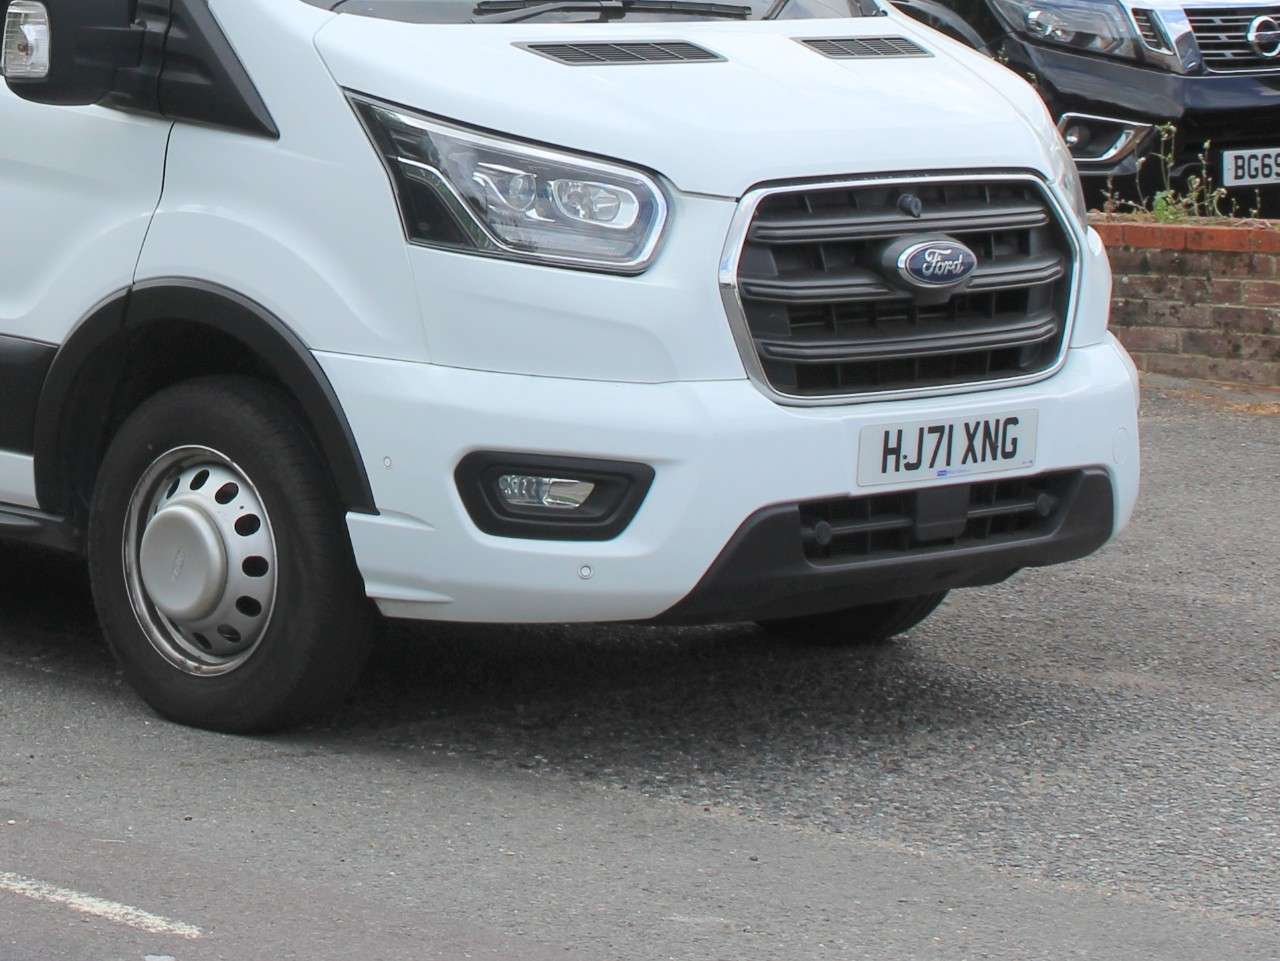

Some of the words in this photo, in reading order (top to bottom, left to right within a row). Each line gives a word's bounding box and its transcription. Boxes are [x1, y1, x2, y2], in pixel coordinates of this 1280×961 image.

[922, 248, 964, 277] Ford
[881, 424, 954, 474] HJ71
[961, 416, 1019, 465] XNG
